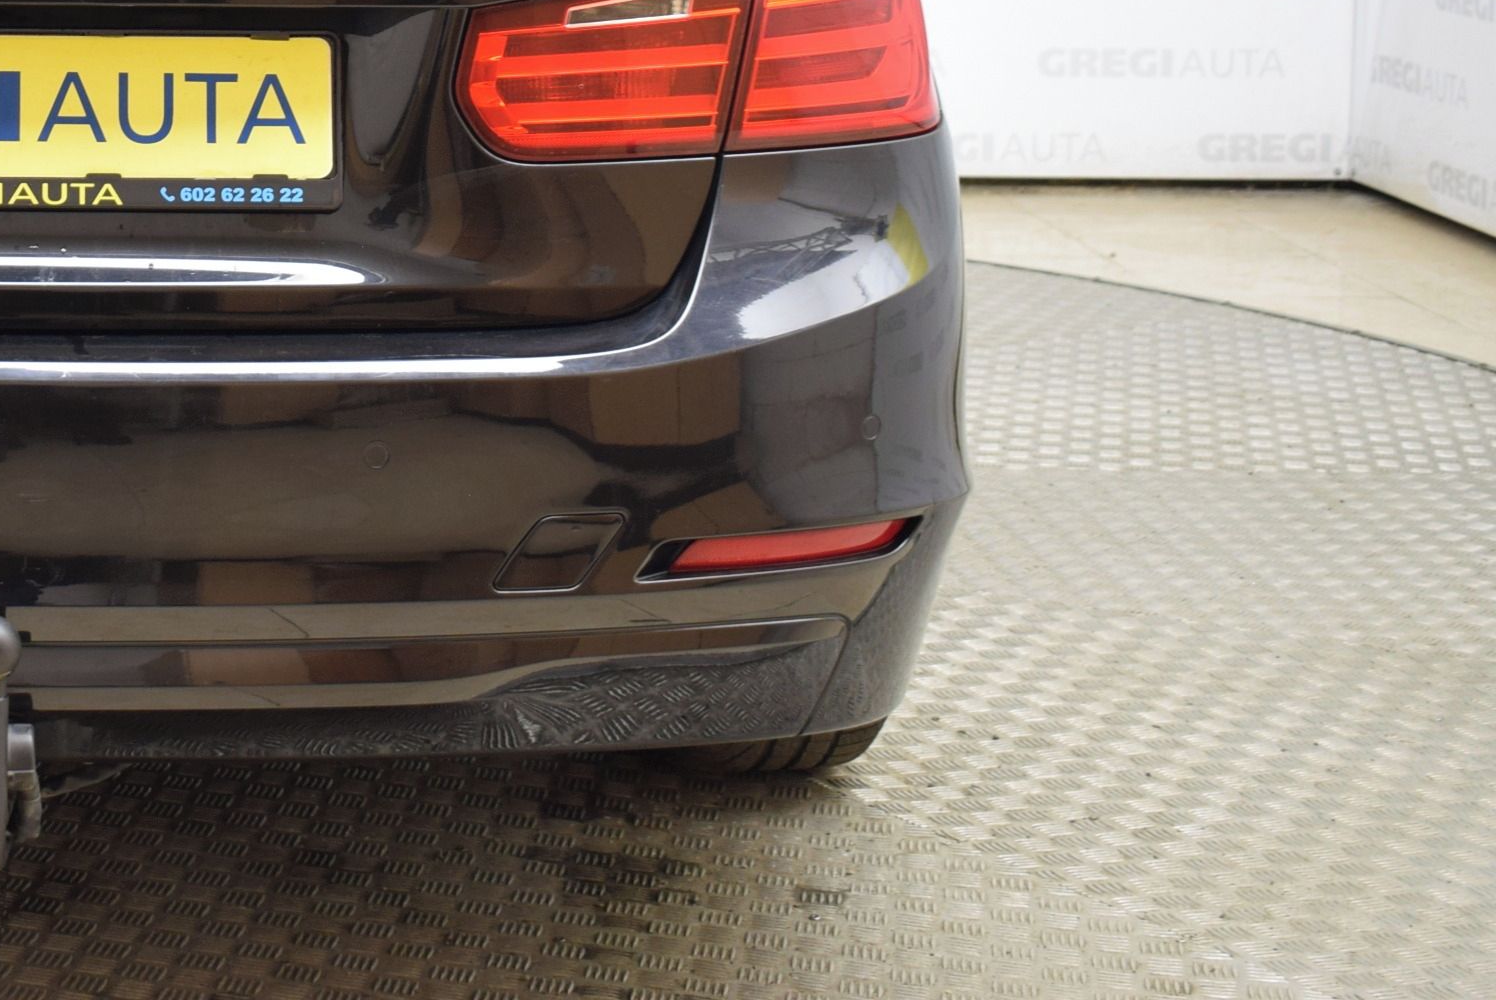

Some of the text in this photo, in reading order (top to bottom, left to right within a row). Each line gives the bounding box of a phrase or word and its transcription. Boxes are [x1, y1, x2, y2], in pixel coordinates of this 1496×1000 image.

[1037, 47, 1286, 80] GREGIAUTA
[180, 187, 304, 202] 602 62 26 22
